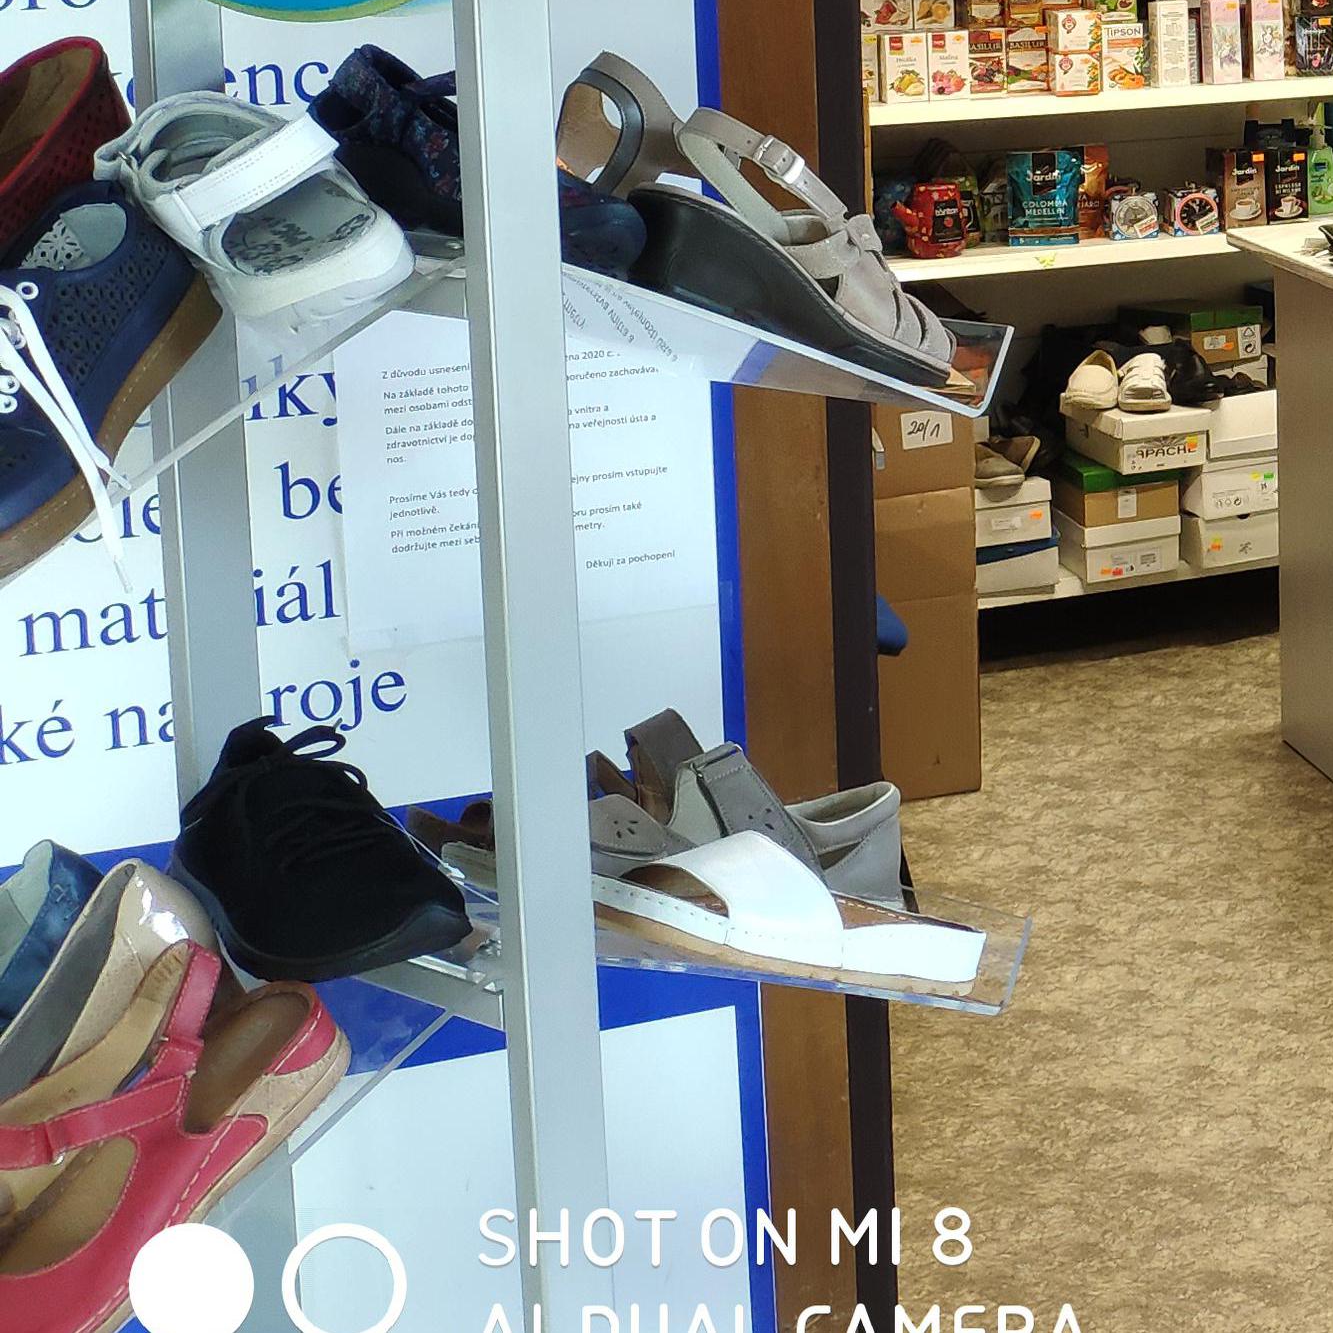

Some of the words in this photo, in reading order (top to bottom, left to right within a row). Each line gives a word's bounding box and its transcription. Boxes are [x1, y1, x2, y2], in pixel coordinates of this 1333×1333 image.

[1104, 27, 1142, 37] TIPSON
[382, 370, 388, 380] Z
[389, 368, 426, 378] důvodu
[582, 350, 605, 359] 2020
[384, 391, 397, 400] Na
[399, 387, 434, 398] základě
[437, 384, 469, 394] tohoto
[384, 405, 407, 414] mezi
[409, 400, 449, 412] osobami
[574, 404, 601, 414] vnitra
[386, 424, 406, 435] Dále
[409, 423, 421, 431] na
[424, 418, 459, 430] základě
[582, 416, 627, 428] veřejnosti
[630, 414, 648, 423] ústa
[386, 436, 447, 450] zdravotnictví
[449, 435, 458, 445] je
[387, 455, 406, 464] nos.
[389, 492, 427, 504] Prosíme
[429, 489, 447, 499] Vás
[449, 487, 470, 499] tedy
[593, 469, 624, 483] prosím
[626, 465, 668, 478] vstupujte
[390, 506, 440, 521] jednotlivě.
[391, 528, 404, 539] Při
[406, 524, 447, 537] možném
[589, 503, 620, 518] prosím
[623, 501, 642, 512] také
[391, 539, 437, 554] dodržujte
[440, 537, 462, 547] mezi
[586, 557, 614, 569] Děkuji
[616, 557, 626, 566] za
[628, 550, 675, 566] pochopení
